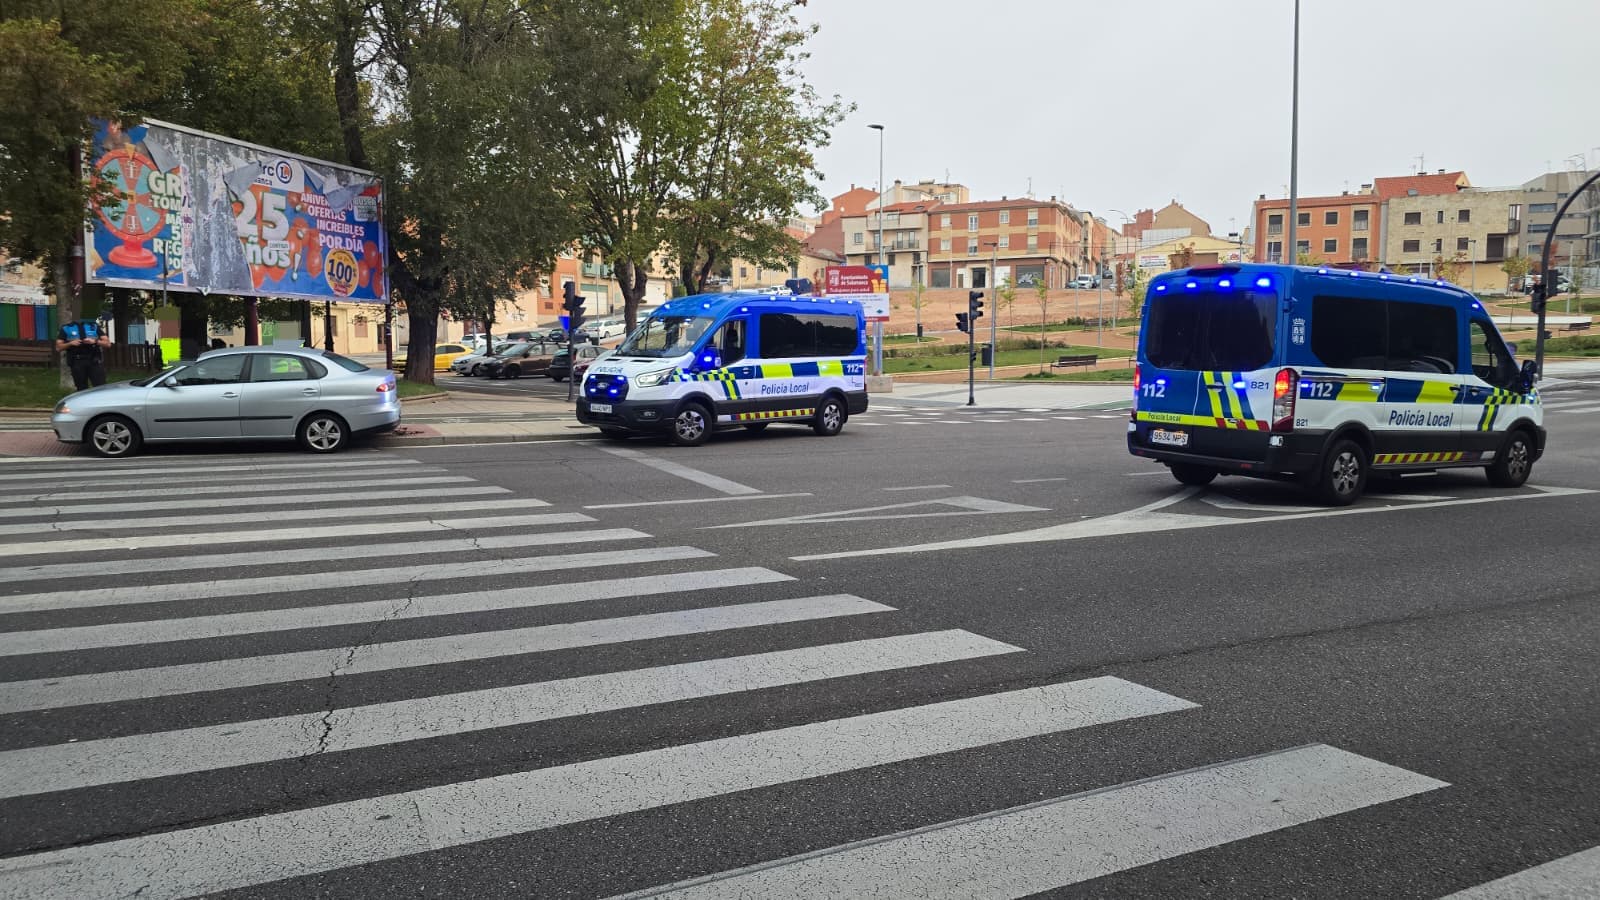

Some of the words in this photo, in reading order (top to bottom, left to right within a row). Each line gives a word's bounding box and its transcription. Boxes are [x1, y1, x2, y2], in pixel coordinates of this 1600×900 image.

[236, 189, 289, 241] 25
[328, 259, 353, 283] 100
[847, 364, 859, 373] 112
[789, 382, 809, 393] Local
[1142, 383, 1166, 398] 112
[1251, 381, 1269, 389] 821
[1311, 383, 1333, 397] 112
[1296, 419, 1308, 427] 821
[1388, 409, 1425, 426] Policía
[1426, 411, 1454, 427] Local
